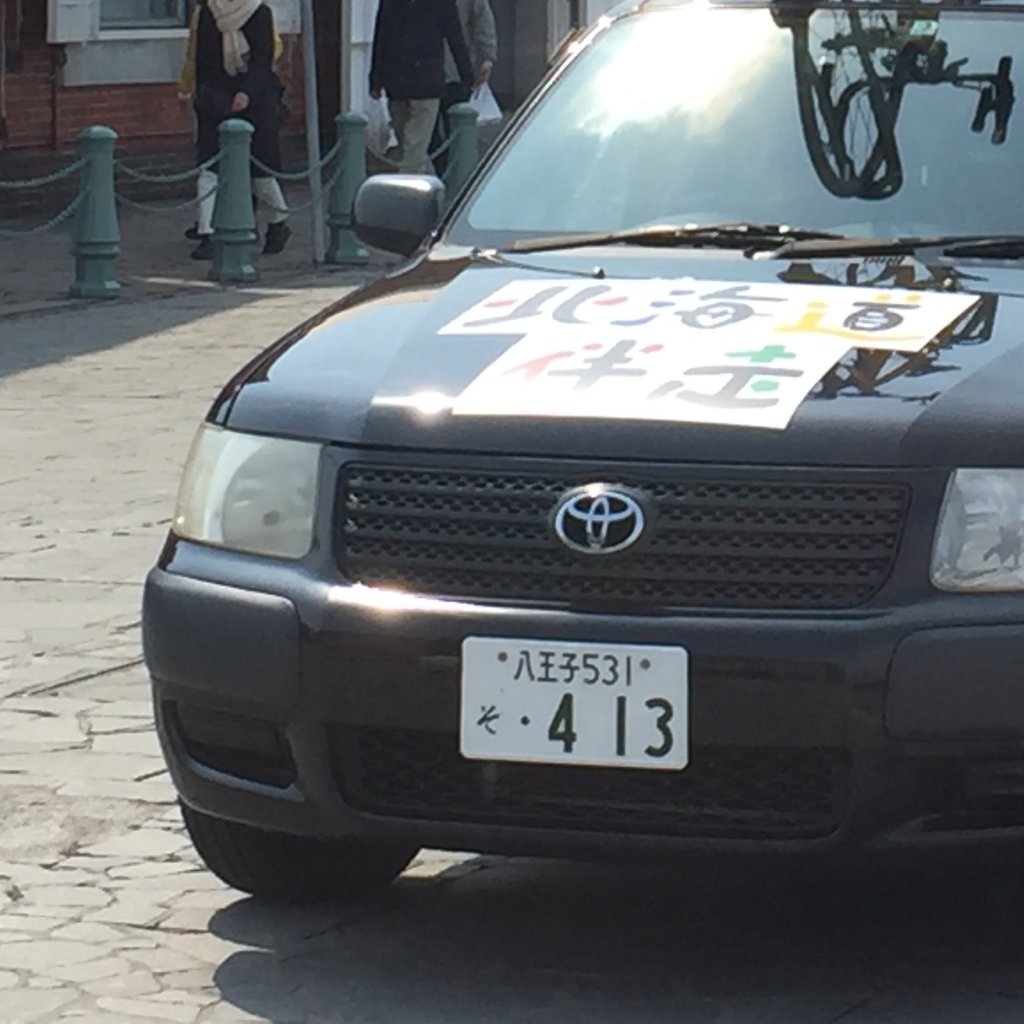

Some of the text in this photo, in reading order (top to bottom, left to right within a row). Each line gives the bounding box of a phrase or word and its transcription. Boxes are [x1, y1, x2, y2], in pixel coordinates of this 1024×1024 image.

[463, 280, 925, 342] 北海道
[513, 650, 632, 686] 八王子531
[476, 704, 502, 736] そ
